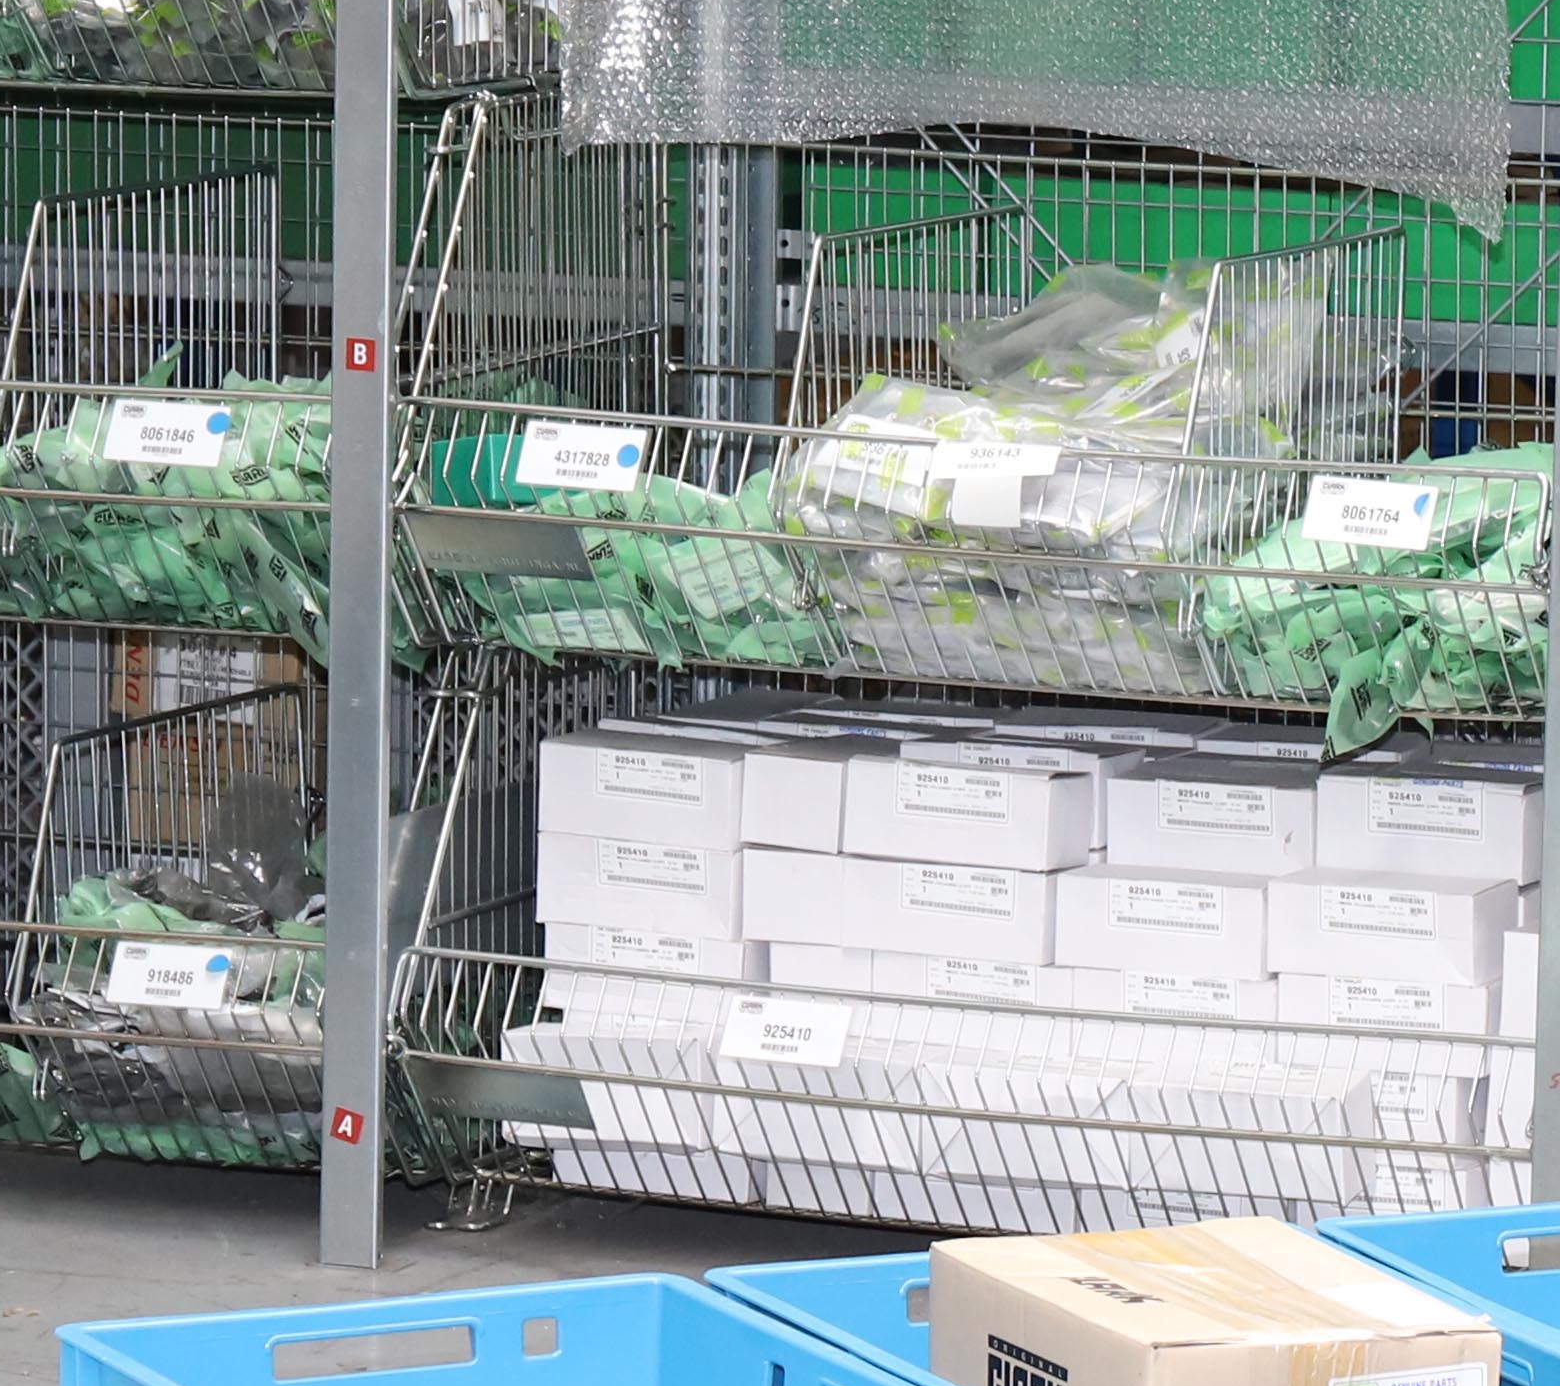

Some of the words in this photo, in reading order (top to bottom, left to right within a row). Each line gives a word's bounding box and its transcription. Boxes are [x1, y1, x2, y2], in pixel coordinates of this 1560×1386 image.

[353, 344, 368, 365] B
[141, 426, 195, 444] 8061846
[554, 448, 610, 467] 4317828
[1341, 505, 1400, 523] 8061764
[1064, 731, 1095, 742] 925410
[614, 754, 646, 766] 925410
[978, 756, 1010, 766] 925410
[917, 773, 948, 785] 925410
[1178, 788, 1210, 800] 925410
[1388, 791, 1421, 802] 925410
[617, 846, 648, 857] 925410
[922, 870, 954, 881] 925410
[1128, 886, 1161, 897] 925410
[1340, 891, 1372, 902] 925410
[611, 935, 643, 946] 925410
[947, 960, 978, 971] 925410
[147, 969, 193, 985] 918486
[763, 1023, 812, 1042] 925410
[338, 1116, 352, 1136] A
[993, 1339, 1064, 1379] ORIGINAL
